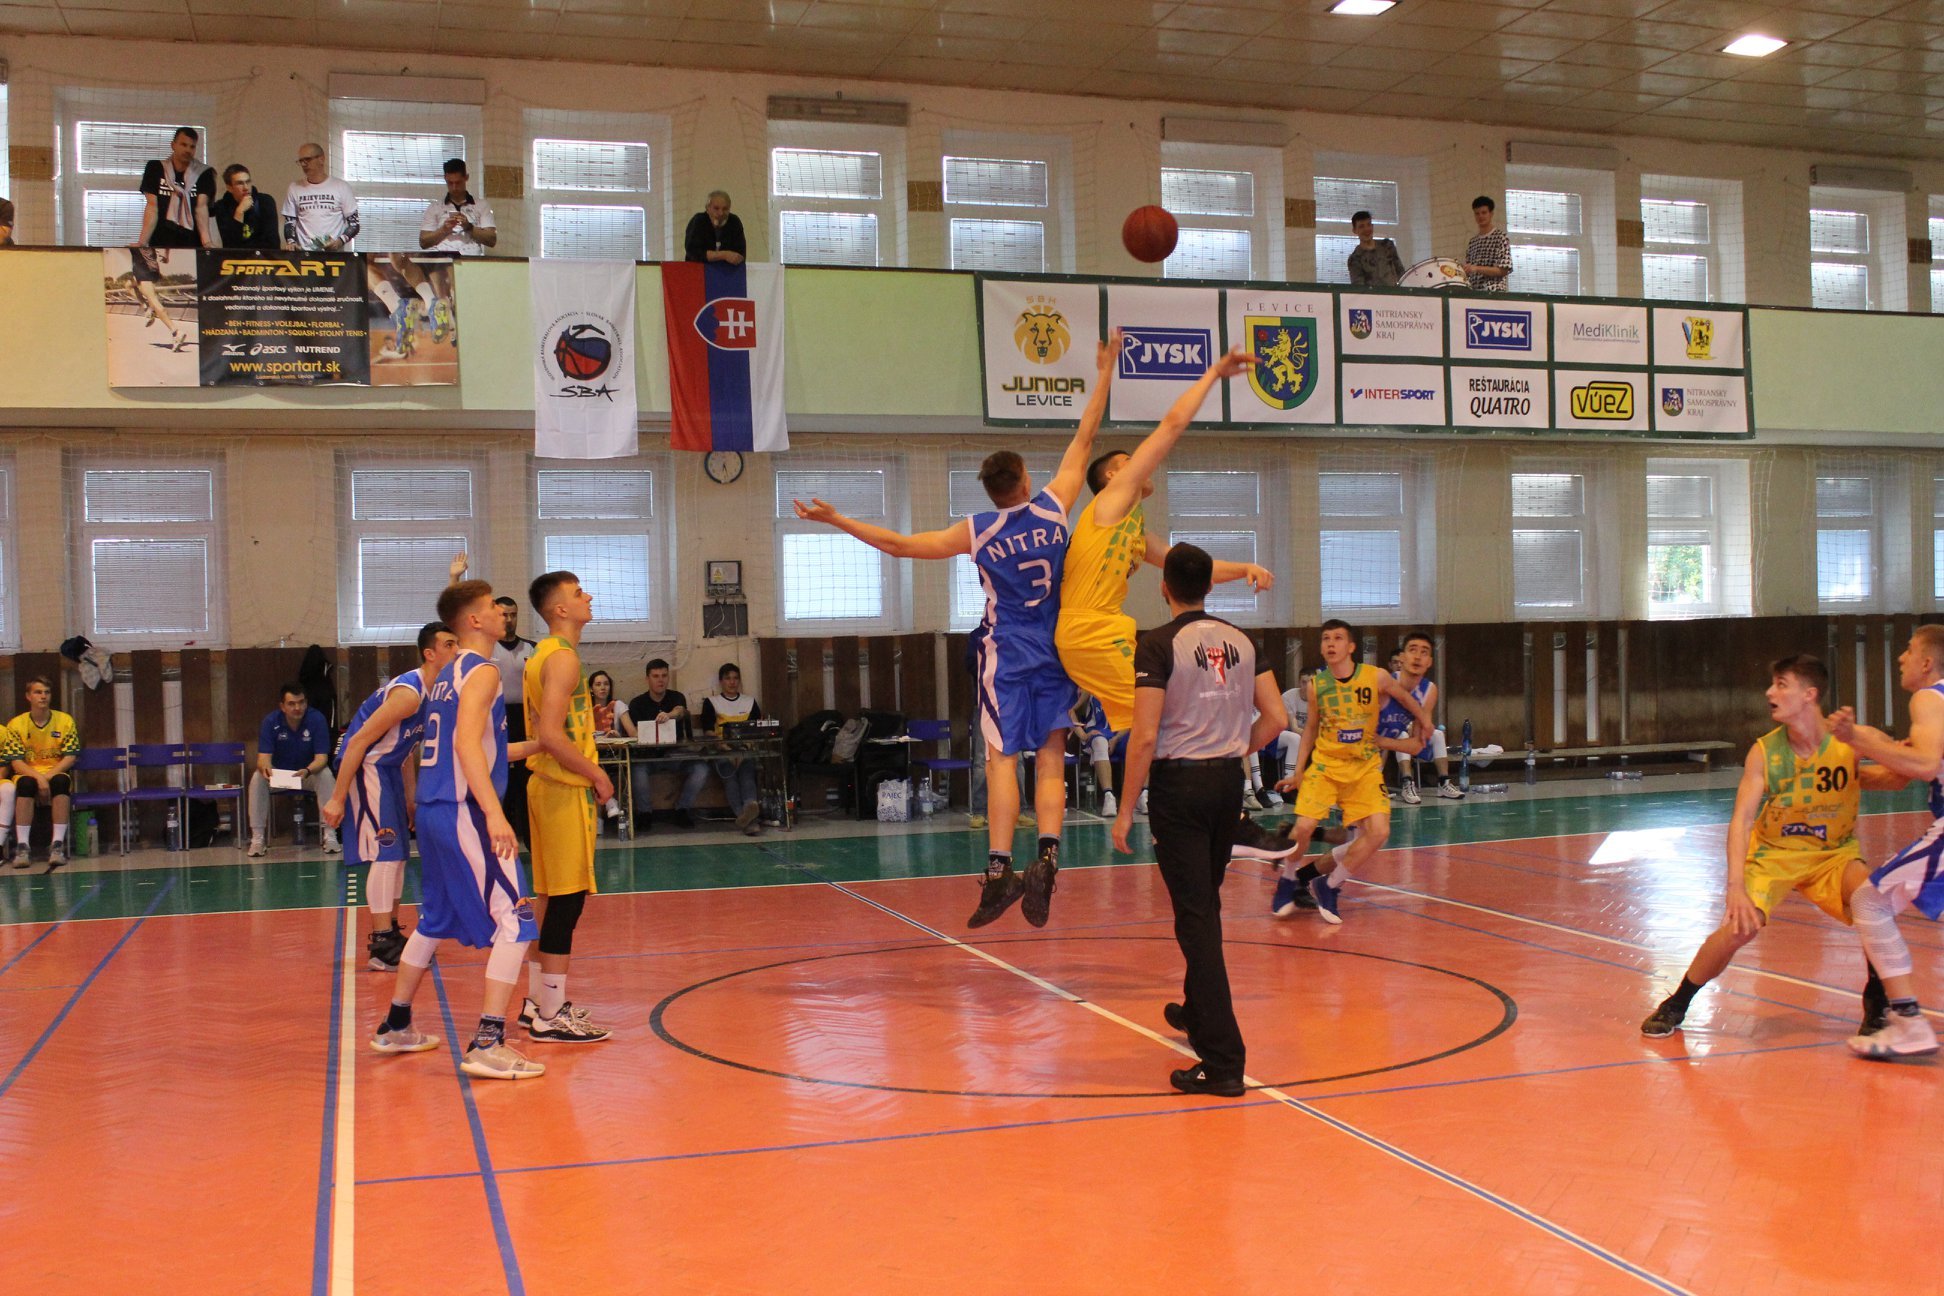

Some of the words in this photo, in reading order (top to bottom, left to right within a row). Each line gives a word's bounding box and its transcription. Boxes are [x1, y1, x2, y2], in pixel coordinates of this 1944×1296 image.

[1246, 302, 1314, 313] LEVICE
[1375, 310, 1424, 320] NITRIANSKY
[345, 329, 364, 337] TENIS
[1375, 320, 1435, 331] SAMOSPRÁVNY
[1481, 321, 1526, 339] JYSK
[1573, 322, 1639, 339] MediKlinik
[1376, 331, 1395, 341] KRAJ
[295, 345, 341, 354] NUTREND
[1140, 343, 1203, 365] JYSK
[229, 360, 341, 375] www.sportart.sk
[1002, 376, 1086, 393] JUNIOR
[549, 383, 620, 403] SBA
[1016, 394, 1073, 407] LEVICE
[1365, 388, 1435, 401] INTERSPORT
[1687, 388, 1727, 398] NITRIANSKY
[1470, 396, 1531, 418] QUATRO
[1687, 408, 1704, 417] KRAJ
[986, 525, 1064, 563] NITRA
[1017, 558, 1052, 607] 3
[1354, 686, 1372, 705] 19
[1816, 765, 1848, 793] 30
